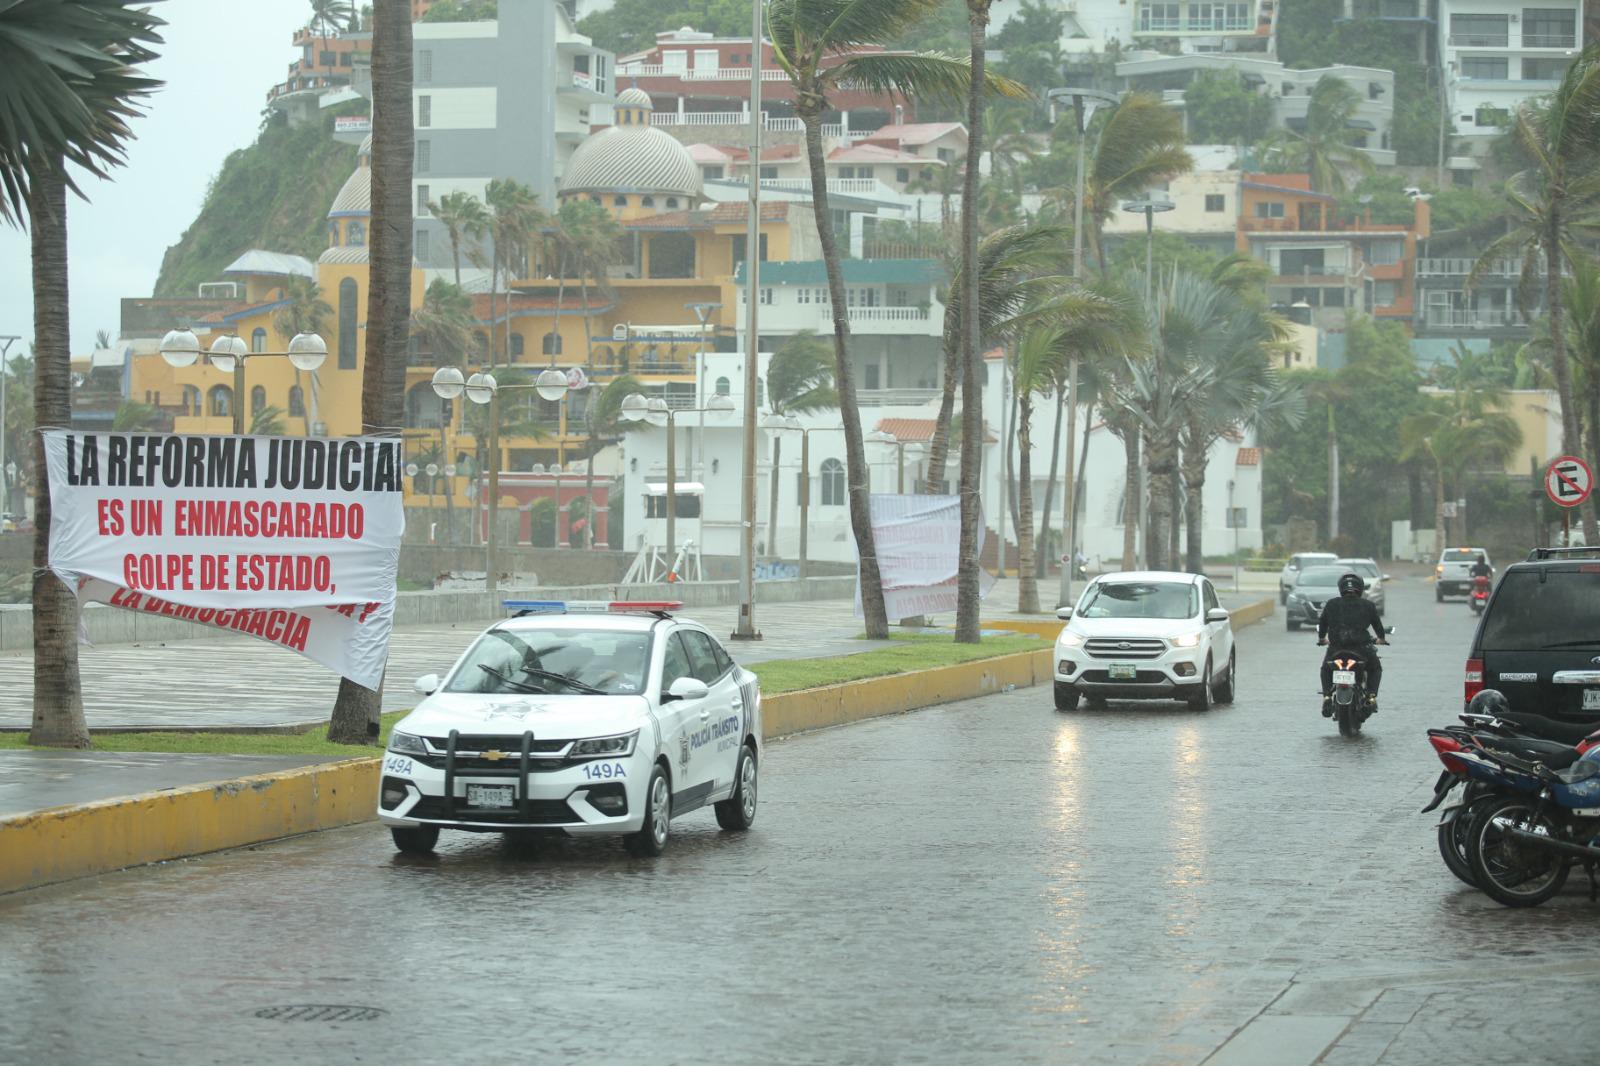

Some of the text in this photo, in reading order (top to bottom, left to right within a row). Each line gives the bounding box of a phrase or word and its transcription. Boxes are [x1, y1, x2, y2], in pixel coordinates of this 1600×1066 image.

[66, 435, 99, 486] LA
[108, 436, 257, 488] REFORMA
[1556, 466, 1581, 496] E
[98, 499, 364, 539] ES UN ENMASCARADO
[123, 553, 336, 595] GOLPE DE ESTADO,
[583, 763, 626, 780] 149A
